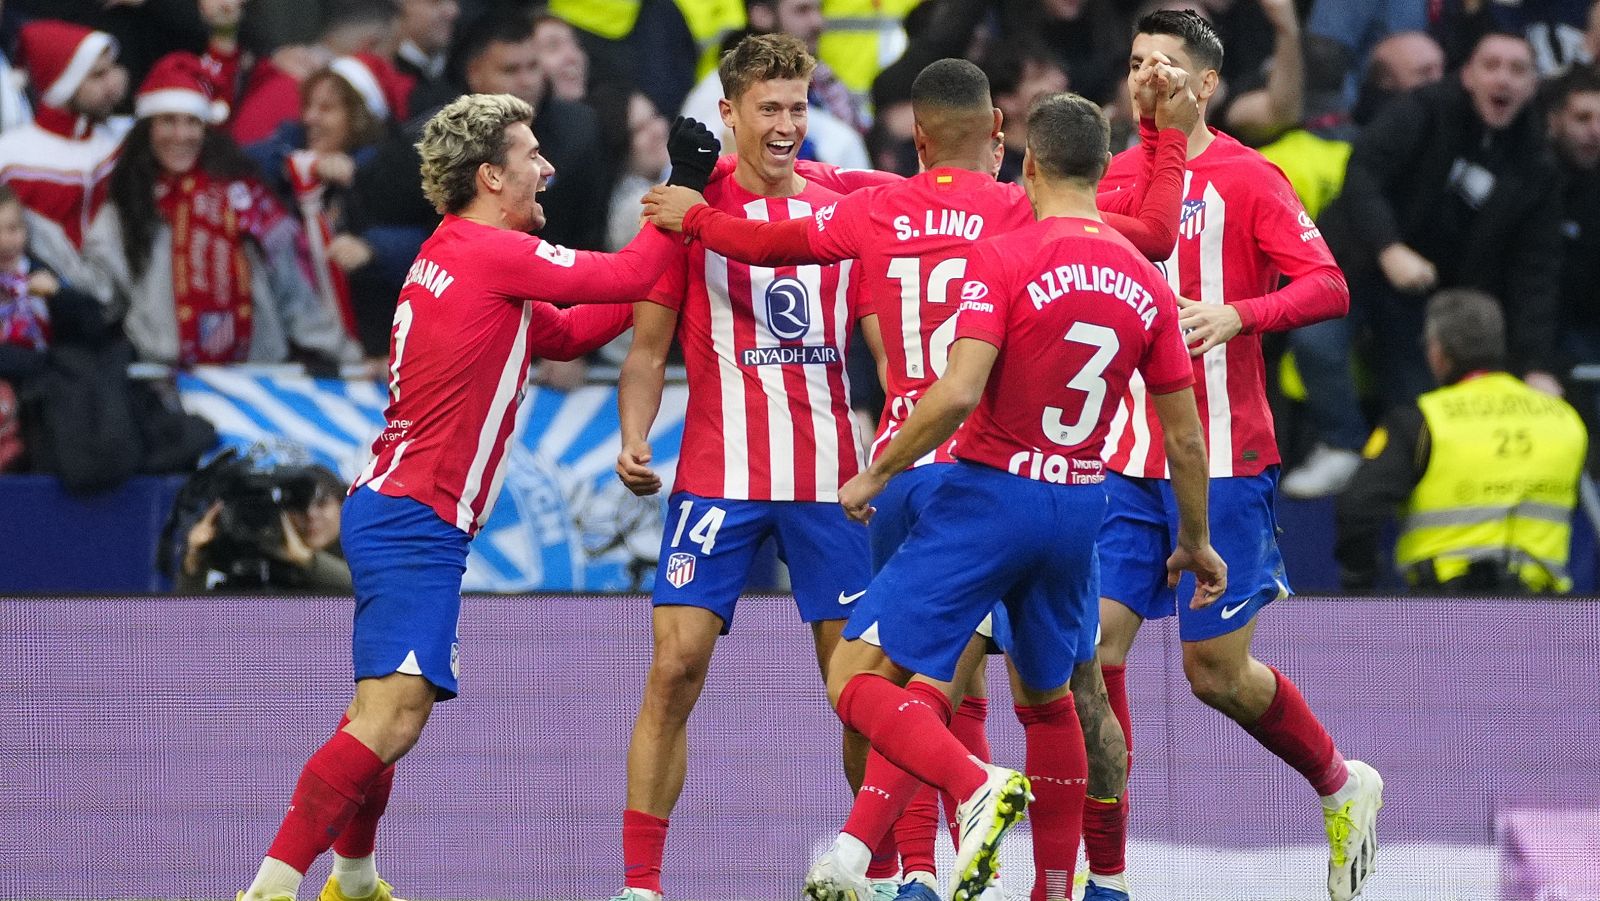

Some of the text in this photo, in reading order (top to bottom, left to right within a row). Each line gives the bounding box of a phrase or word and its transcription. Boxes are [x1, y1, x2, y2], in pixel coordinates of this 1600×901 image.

[893, 209, 985, 241] S. LINO
[1027, 264, 1158, 331] AZPILICUETA
[744, 348, 837, 365] RIYADH AIR
[1041, 321, 1120, 446] 3
[1008, 446, 1069, 484] ria
[1071, 471, 1106, 485] Transfe
[1072, 458, 1103, 472] Money
[671, 500, 727, 556] 14
